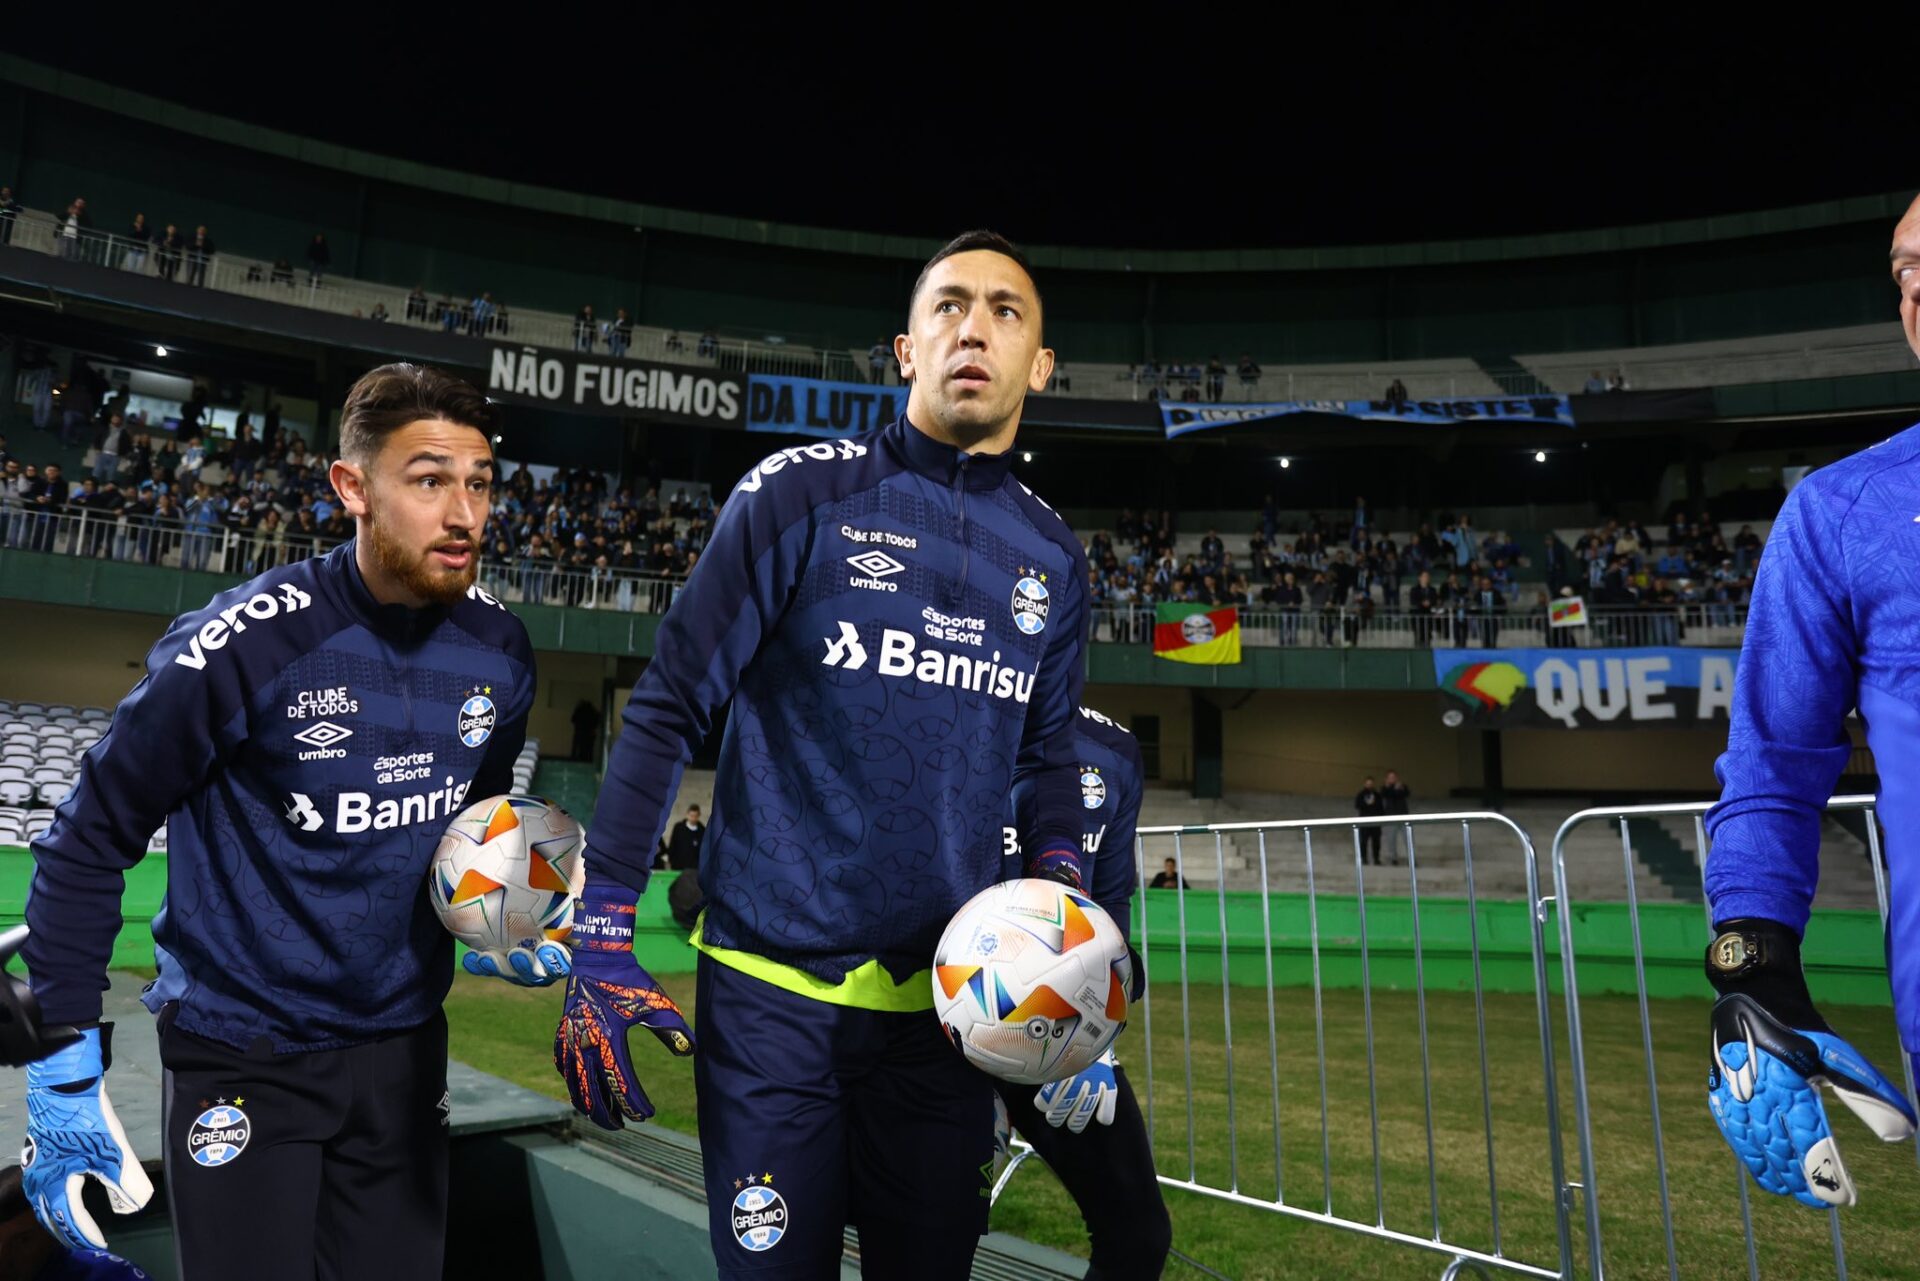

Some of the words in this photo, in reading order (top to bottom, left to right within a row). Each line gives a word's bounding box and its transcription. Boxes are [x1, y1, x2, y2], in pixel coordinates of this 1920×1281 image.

[489, 347, 565, 400] NÃO
[574, 363, 741, 421] FUGIMOS
[749, 377, 796, 426] DA
[806, 386, 897, 430] LUTA
[738, 443, 836, 492] vero
[841, 525, 868, 543] CLUBE
[870, 531, 883, 543] DE
[885, 531, 917, 549] TODOS
[849, 576, 898, 593] umbro
[1014, 595, 1048, 617] GRÊMIO
[922, 606, 986, 631] Esportes
[175, 593, 279, 670] vero
[944, 627, 983, 646] Sorte
[878, 628, 1040, 704] Banrisu
[298, 686, 348, 706] CLUBE
[1534, 656, 1676, 728] QUE
[287, 705, 307, 719] DE
[309, 699, 359, 717] TODOS
[461, 714, 494, 731] GRÊMIO
[298, 748, 348, 761] umbro
[373, 752, 434, 771] Esportes
[393, 766, 432, 782] Sorte
[336, 775, 472, 834] Banris
[572, 923, 597, 934] BIANC
[584, 914, 611, 926] (AM1)
[601, 926, 632, 937] VALEN
[191, 1128, 247, 1146] GRÊMIO
[735, 1208, 784, 1229] GRÊMIO
